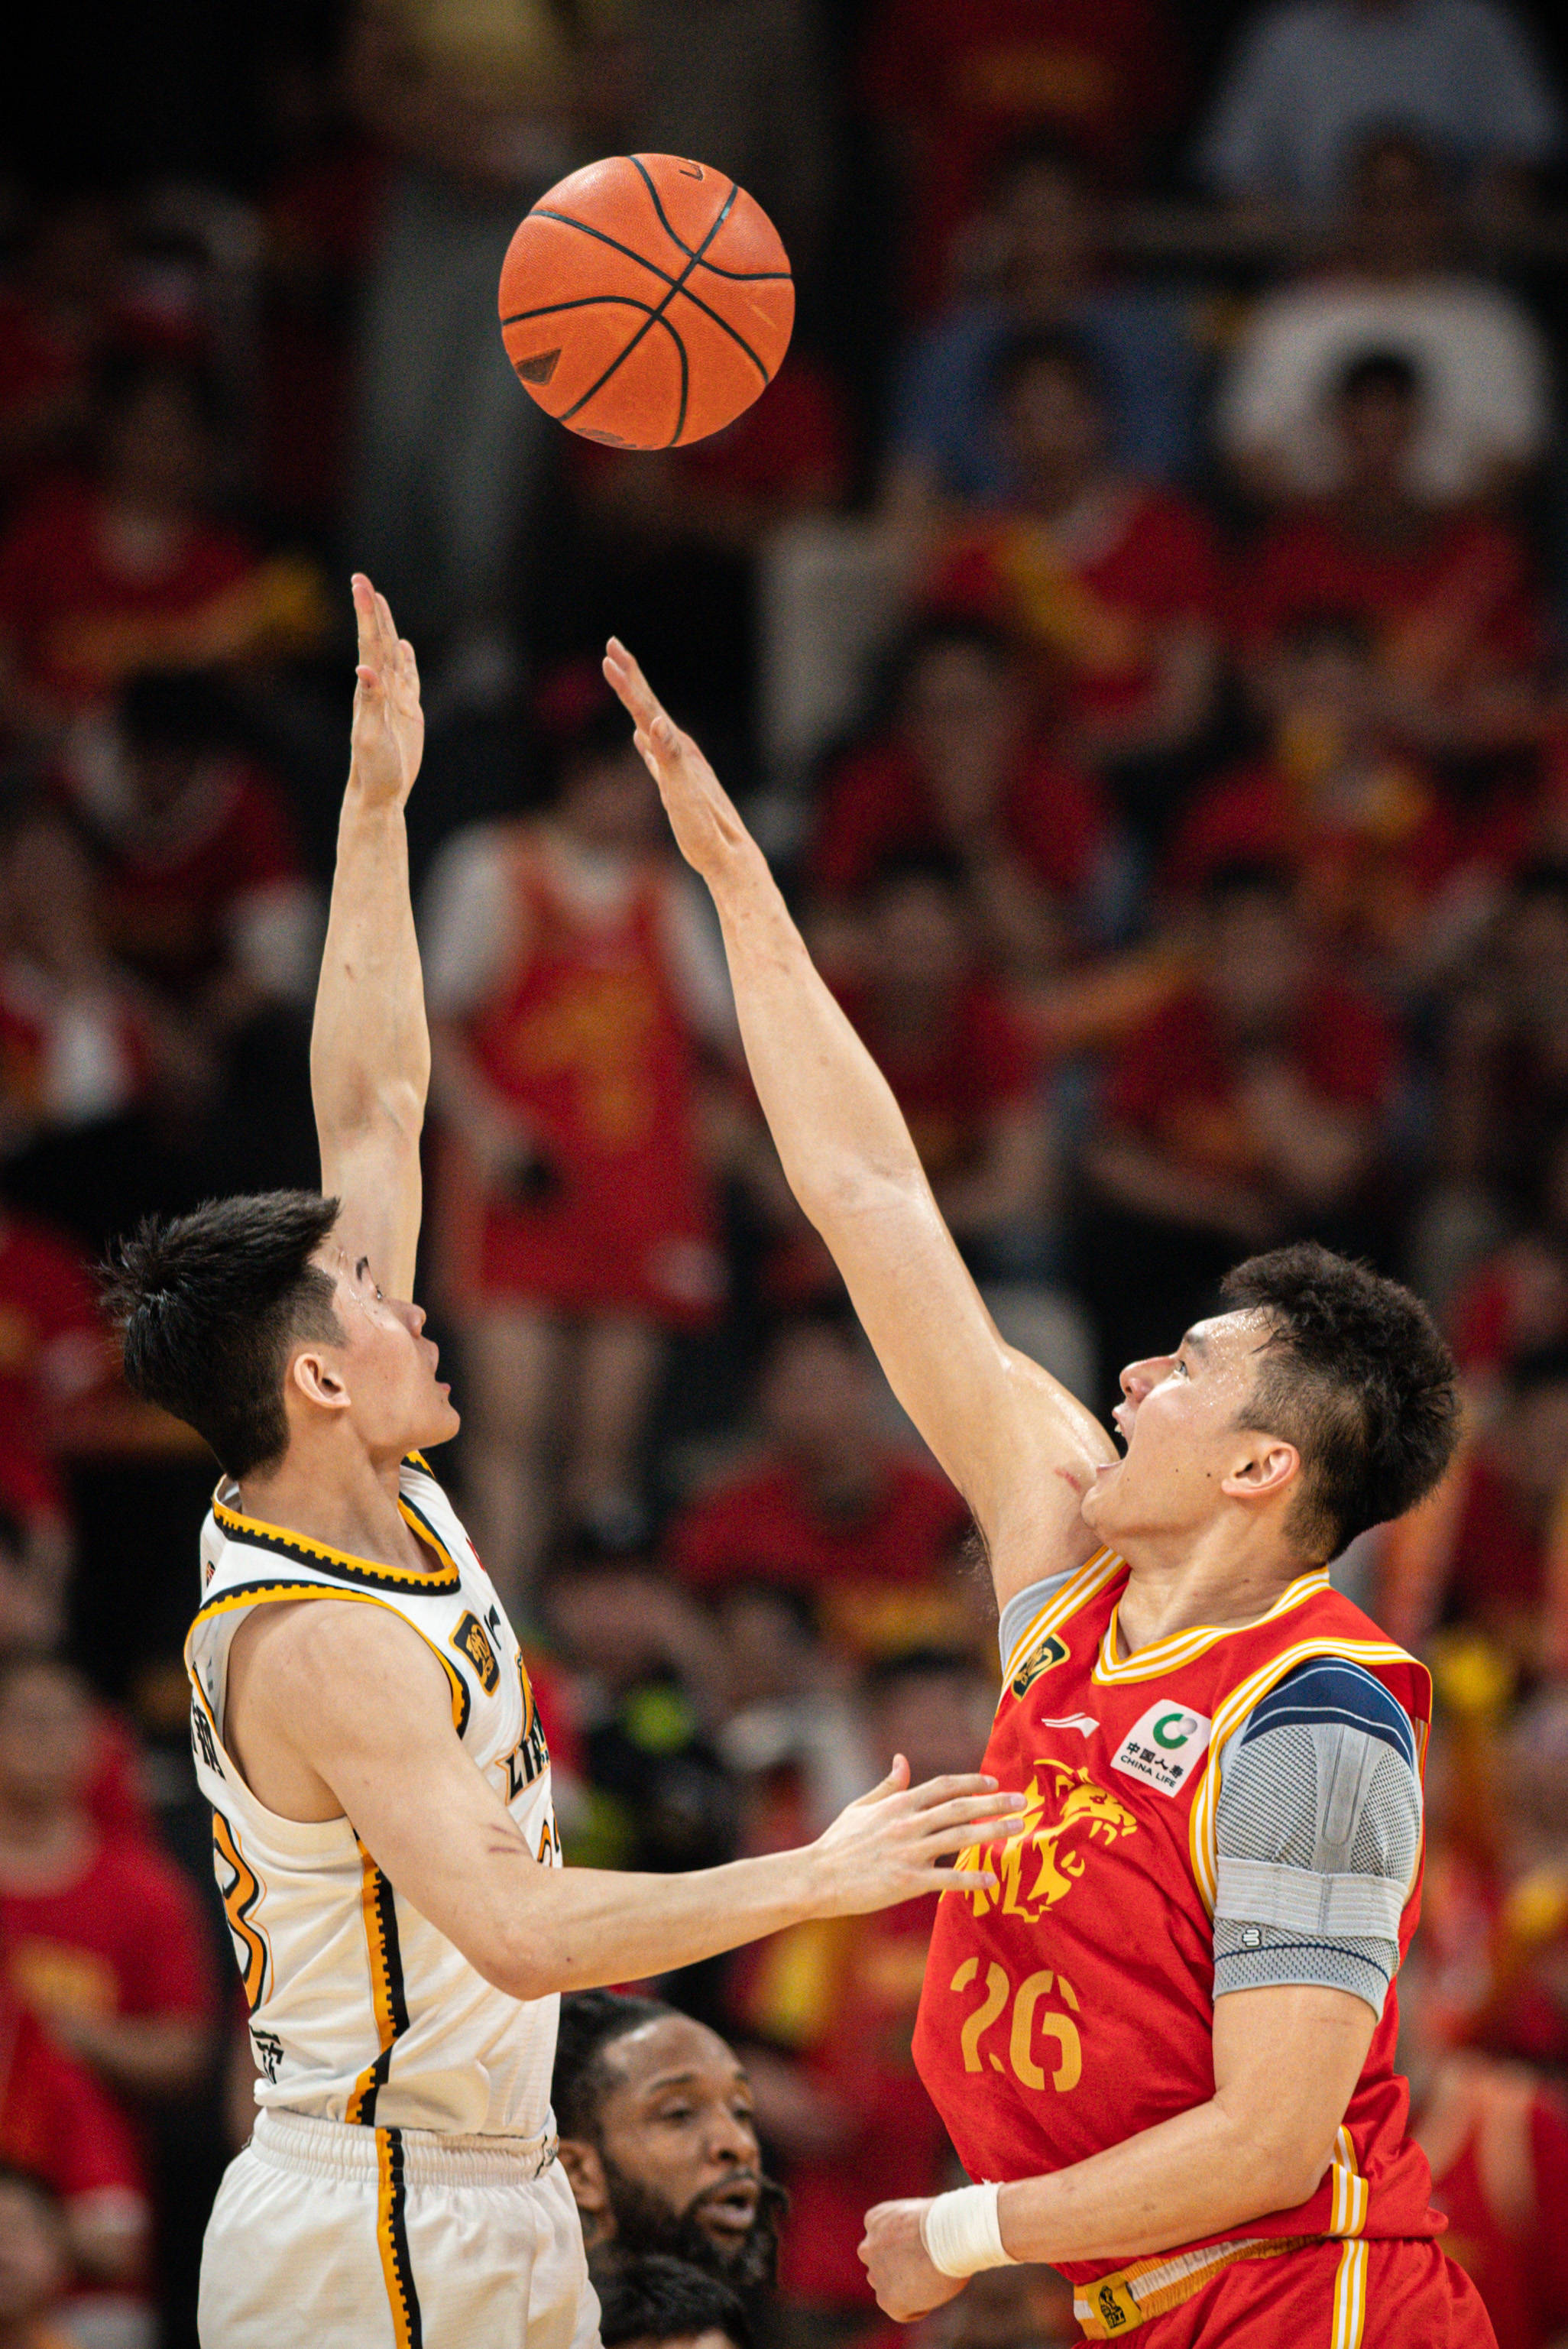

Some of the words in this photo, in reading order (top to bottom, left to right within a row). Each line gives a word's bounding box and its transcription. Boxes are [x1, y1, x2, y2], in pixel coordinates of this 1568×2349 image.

[1120, 1754, 1153, 1777] CHINA
[1155, 1772, 1177, 1788] LIFE
[950, 1958, 1082, 2091] 26
